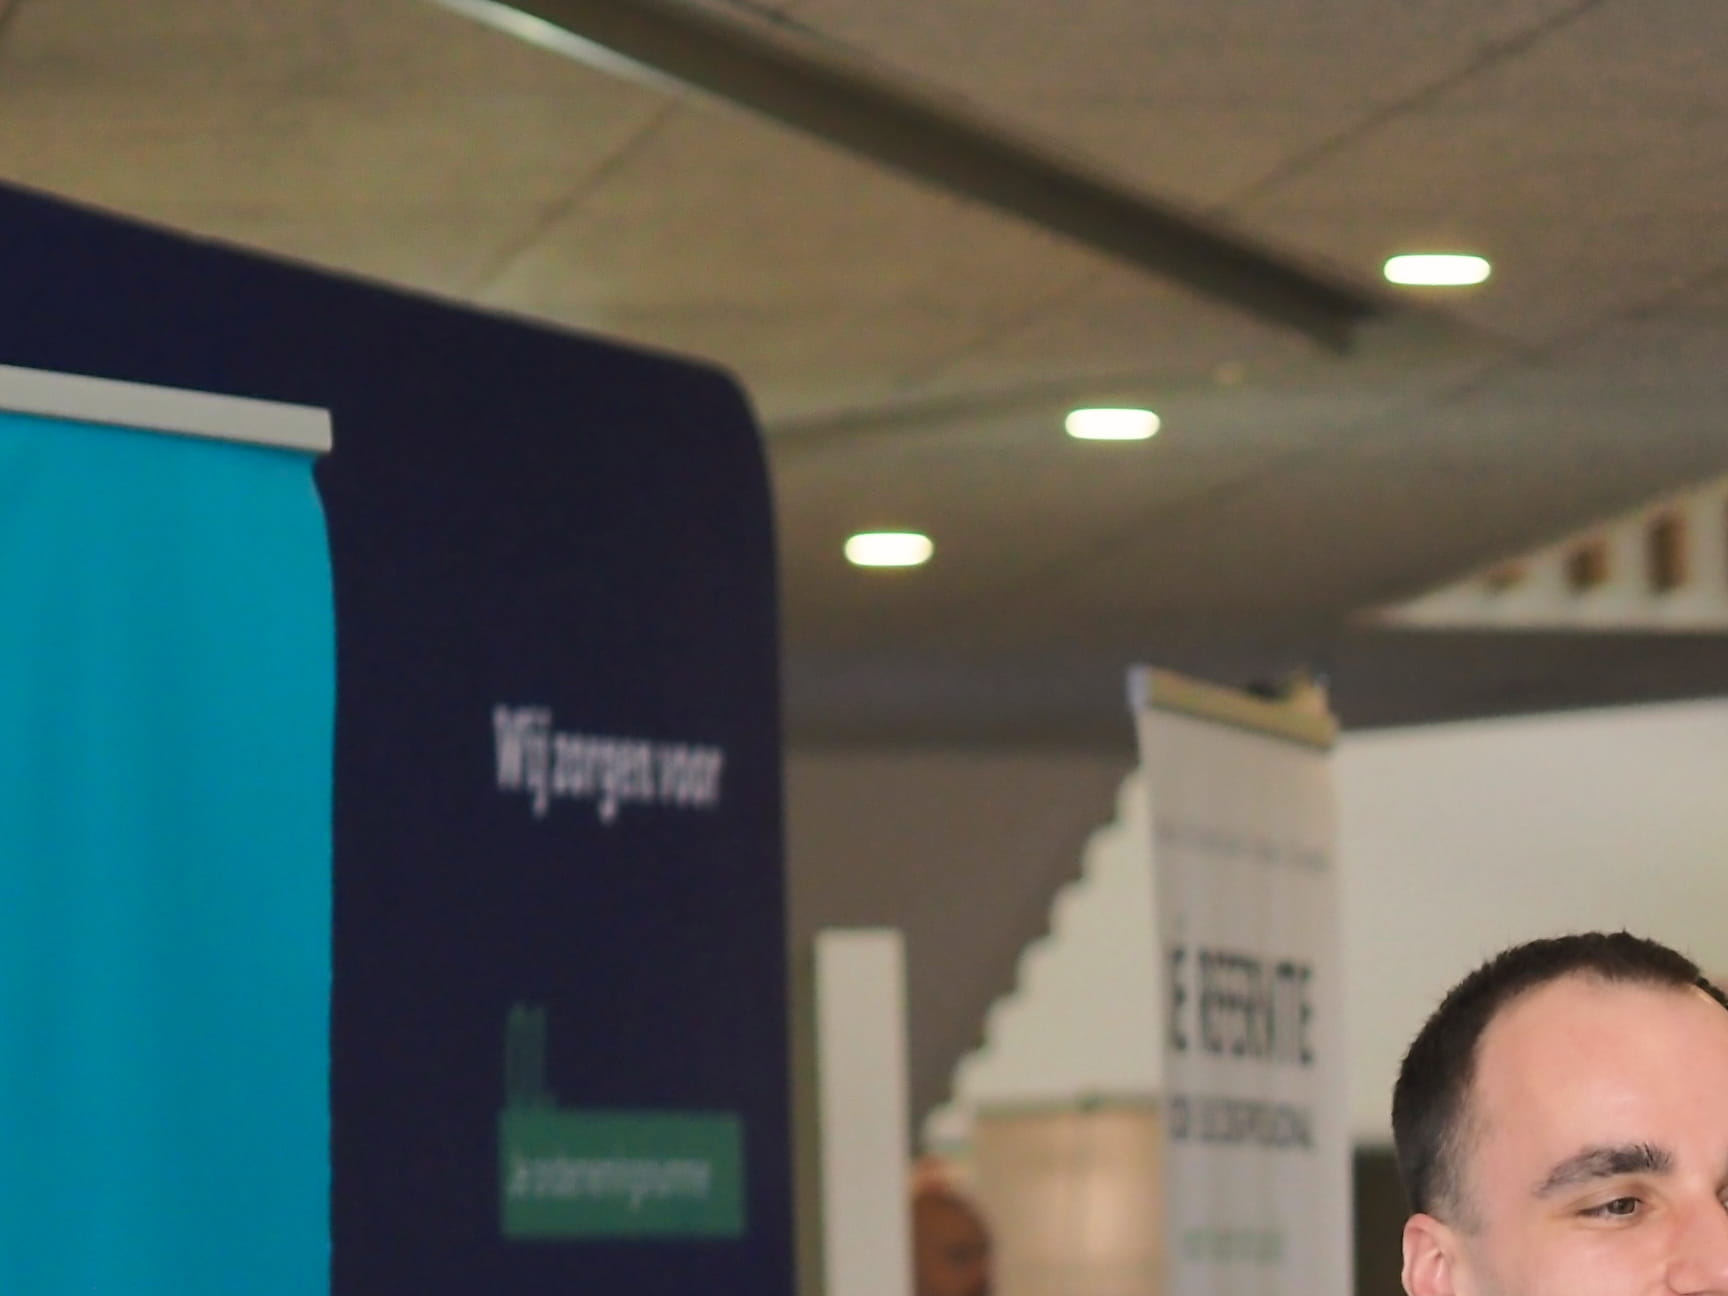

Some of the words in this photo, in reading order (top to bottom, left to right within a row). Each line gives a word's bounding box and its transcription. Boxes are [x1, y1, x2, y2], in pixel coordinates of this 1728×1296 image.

[493, 704, 552, 820] Wij
[553, 732, 653, 826] zorgen
[656, 741, 725, 809] voor
